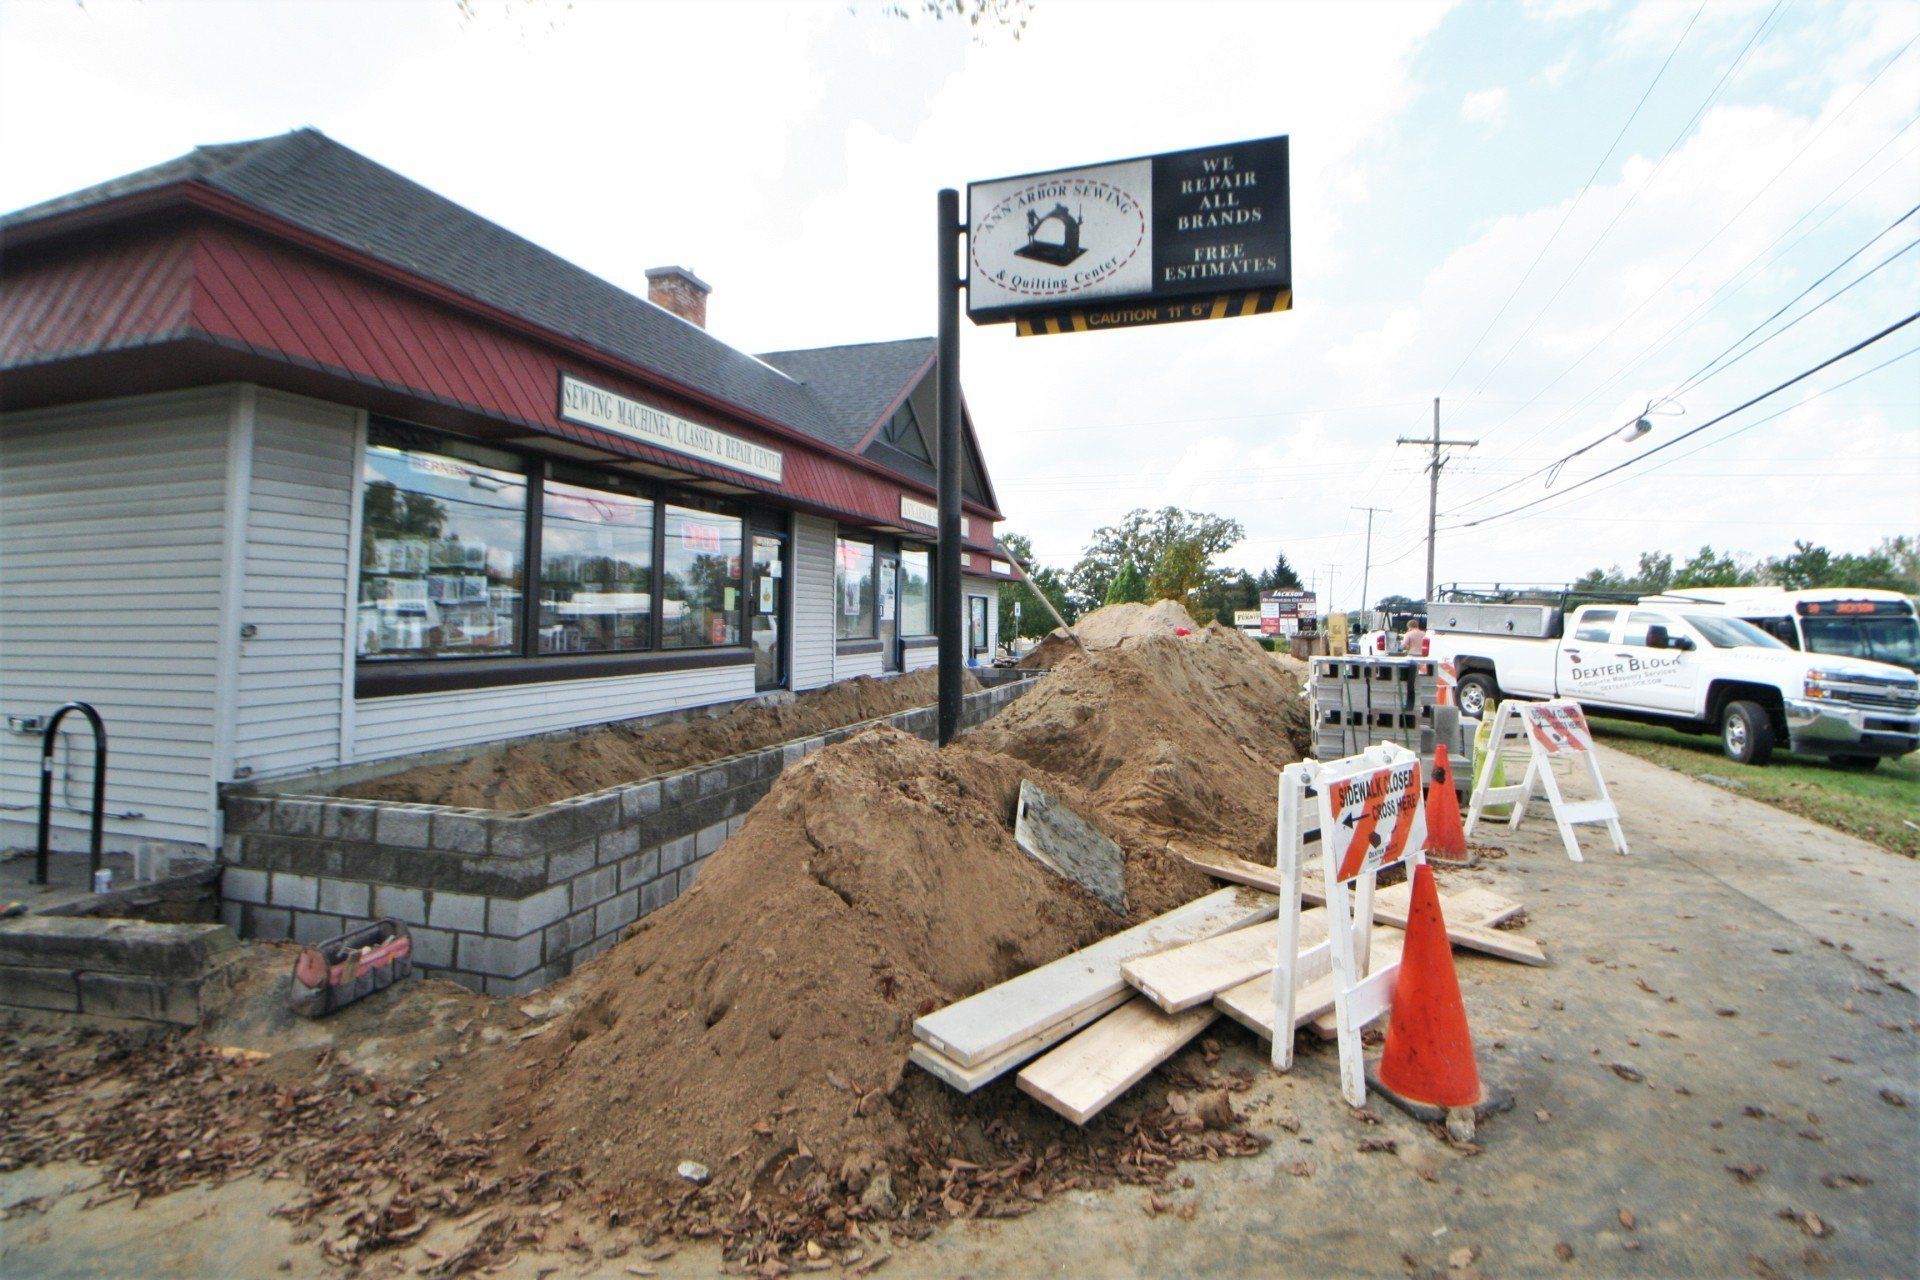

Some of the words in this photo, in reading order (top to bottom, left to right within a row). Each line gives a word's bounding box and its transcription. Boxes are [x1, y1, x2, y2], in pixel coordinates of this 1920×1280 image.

[1203, 156, 1235, 172] WE
[1181, 171, 1257, 194] REPAIR
[985, 204, 1012, 233] ANN
[1018, 185, 1067, 208] ARBOR
[1074, 185, 1132, 214] SEWING
[1200, 193, 1239, 210] ALL
[1178, 208, 1262, 231] BRANDS
[1194, 243, 1245, 262] FREE
[996, 269, 1006, 280] &
[1012, 274, 1068, 290] Quilting
[1074, 256, 1118, 283] Center
[1164, 257, 1277, 282] ESTIMATES
[1089, 306, 1157, 326] CAUTION
[564, 381, 612, 420] SEWING
[677, 420, 713, 452] CLASSES
[716, 435, 722, 455] &
[726, 438, 752, 465] REPAIR
[754, 448, 781, 474] CENTER
[1572, 663, 1624, 680] DEXTER
[1629, 655, 1681, 671] BLOCK
[1645, 668, 1677, 677] Services
[1338, 781, 1382, 808] SIDEWALK
[1384, 769, 1414, 794] CLOSED
[1371, 800, 1396, 821] CROSS
[1396, 793, 1417, 816] HERE
